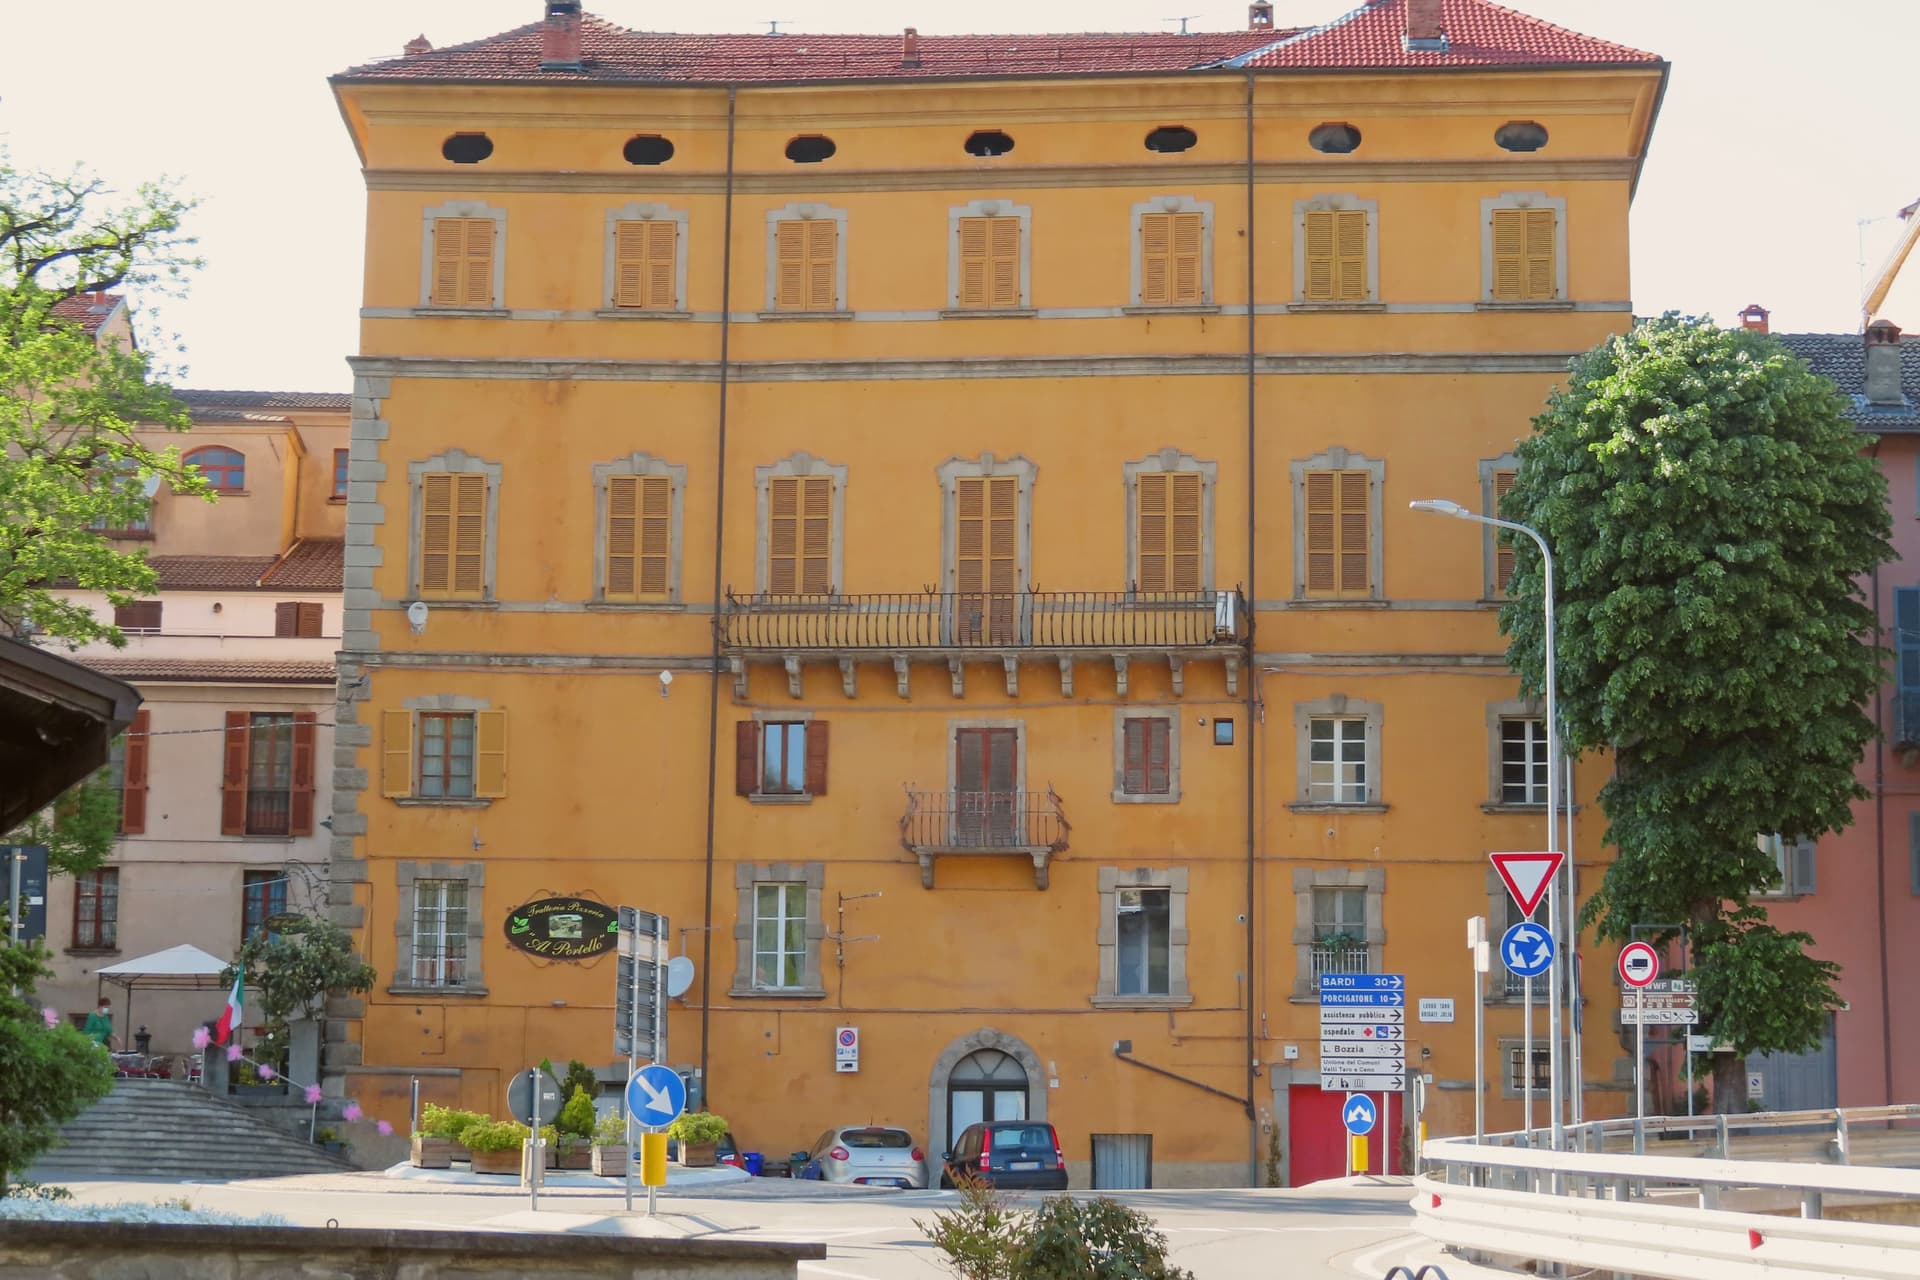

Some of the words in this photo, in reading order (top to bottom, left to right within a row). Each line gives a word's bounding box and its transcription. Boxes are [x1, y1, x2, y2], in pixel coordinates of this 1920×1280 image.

[527, 903, 565, 917] Trattoria
[567, 901, 605, 918] Pizzeria
[1322, 977, 1356, 986] BARDI
[1374, 977, 1389, 986] 30
[1322, 994, 1373, 1003] PORCIGATONE
[1380, 994, 1389, 1003] 10
[1359, 1011, 1386, 1019] pubblica
[1323, 1027, 1355, 1037] ospedale
[1322, 1045, 1331, 1053] L.
[1334, 1045, 1365, 1053] Bozzia
